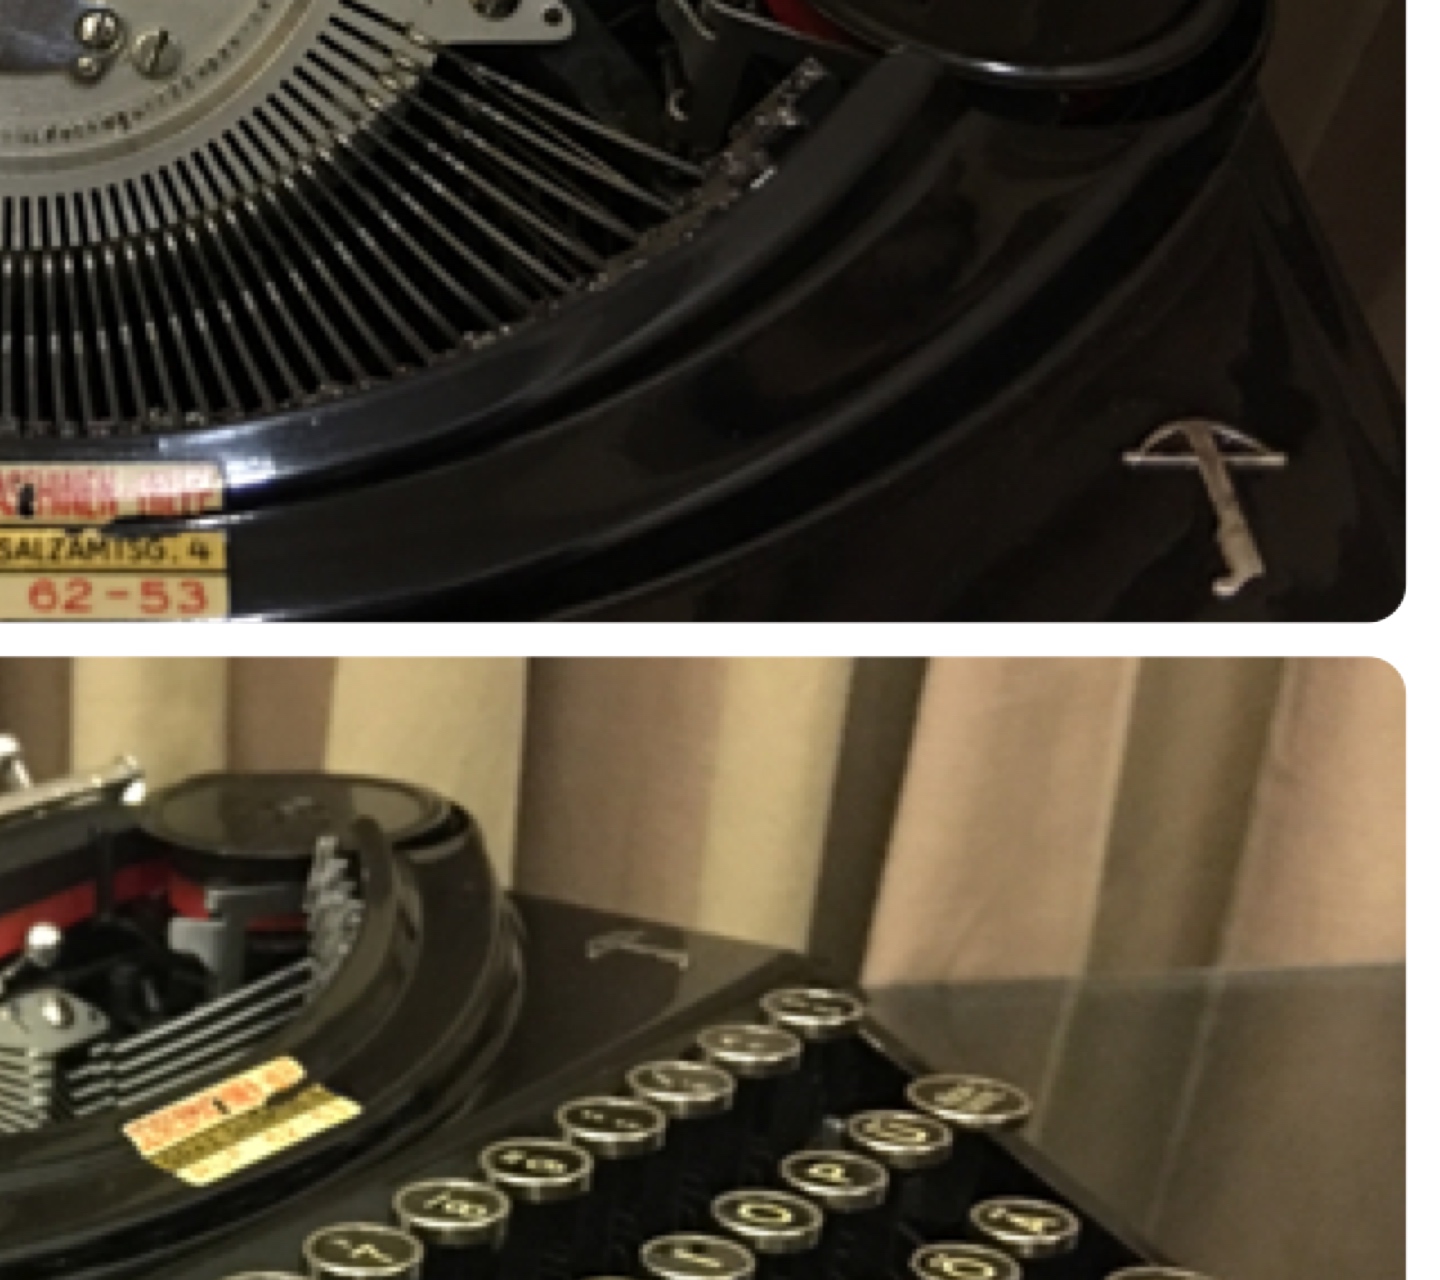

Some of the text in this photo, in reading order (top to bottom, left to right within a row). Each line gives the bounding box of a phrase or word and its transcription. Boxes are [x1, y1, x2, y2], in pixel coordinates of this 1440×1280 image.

[186, 537, 213, 564] 4
[27, 577, 210, 615] 62-53
[808, 1162, 851, 1184] P
